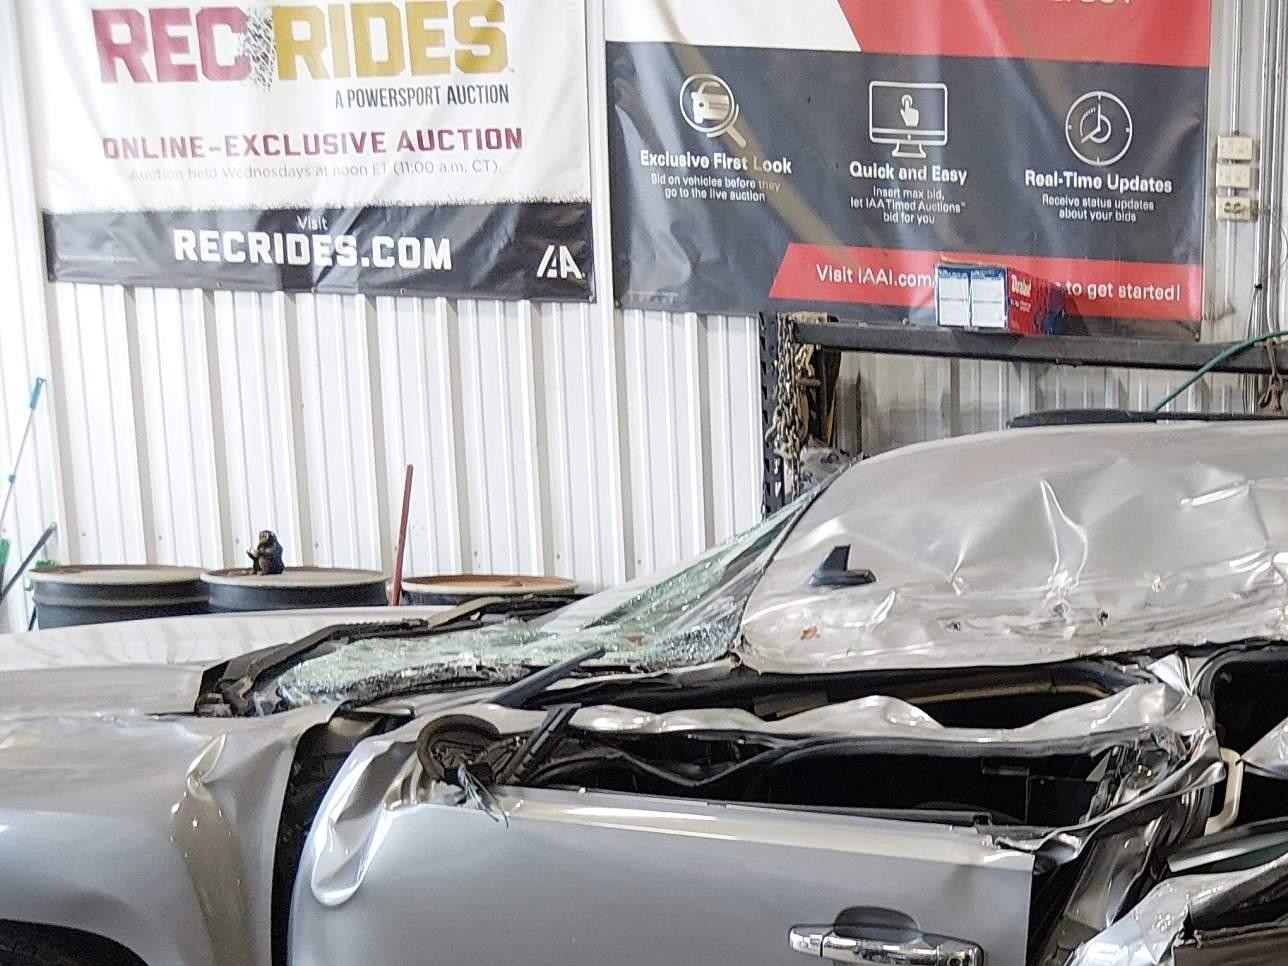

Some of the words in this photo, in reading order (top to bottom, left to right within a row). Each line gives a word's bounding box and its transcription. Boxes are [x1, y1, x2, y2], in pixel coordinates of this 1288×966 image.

[92, 7, 251, 83] REC
[272, 1, 511, 81] RIDES
[335, 89, 344, 109] A
[347, 85, 441, 109] POWERSPORT
[447, 83, 510, 106] AUCTION
[102, 131, 387, 160] ONLINE-EXCLUSIVE
[396, 127, 523, 153] AUCTION
[640, 149, 710, 169] Exclusive
[713, 151, 748, 171] First
[753, 156, 792, 174] Look
[129, 167, 184, 182] Auction
[188, 166, 217, 180] held
[316, 163, 328, 177] at
[333, 164, 368, 177] noon
[849, 160, 895, 180] Quick
[899, 165, 928, 181] and
[932, 165, 967, 186] Easy
[1025, 169, 1102, 189] Real-Time
[1107, 172, 1173, 193] Updates
[651, 173, 666, 185] Bid
[668, 175, 681, 186] on
[683, 174, 722, 188] vehicles
[725, 176, 756, 189] before
[758, 179, 780, 193] they
[873, 185, 900, 198] Insert
[903, 189, 923, 200] max
[665, 187, 677, 199] go
[680, 187, 689, 198] to
[692, 187, 707, 199] the
[709, 189, 727, 200] live
[730, 190, 766, 202] auction
[850, 196, 863, 208] let
[866, 197, 885, 209] IAA
[885, 198, 916, 211] Timed
[1042, 193, 1080, 207] Receive
[1082, 196, 1112, 208] status
[1115, 197, 1155, 211] updates
[297, 214, 328, 231] Visit
[883, 211, 898, 223] bid
[900, 210, 914, 223] for
[917, 214, 935, 226] you
[1059, 207, 1088, 220] about
[1090, 210, 1112, 223] your
[1115, 210, 1136, 223] bids
[173, 228, 452, 271] RECRIDES.COM
[816, 264, 853, 283] Visit
[1066, 279, 1082, 296] to
[1087, 281, 1113, 301] get
[1118, 283, 1181, 302] started!
